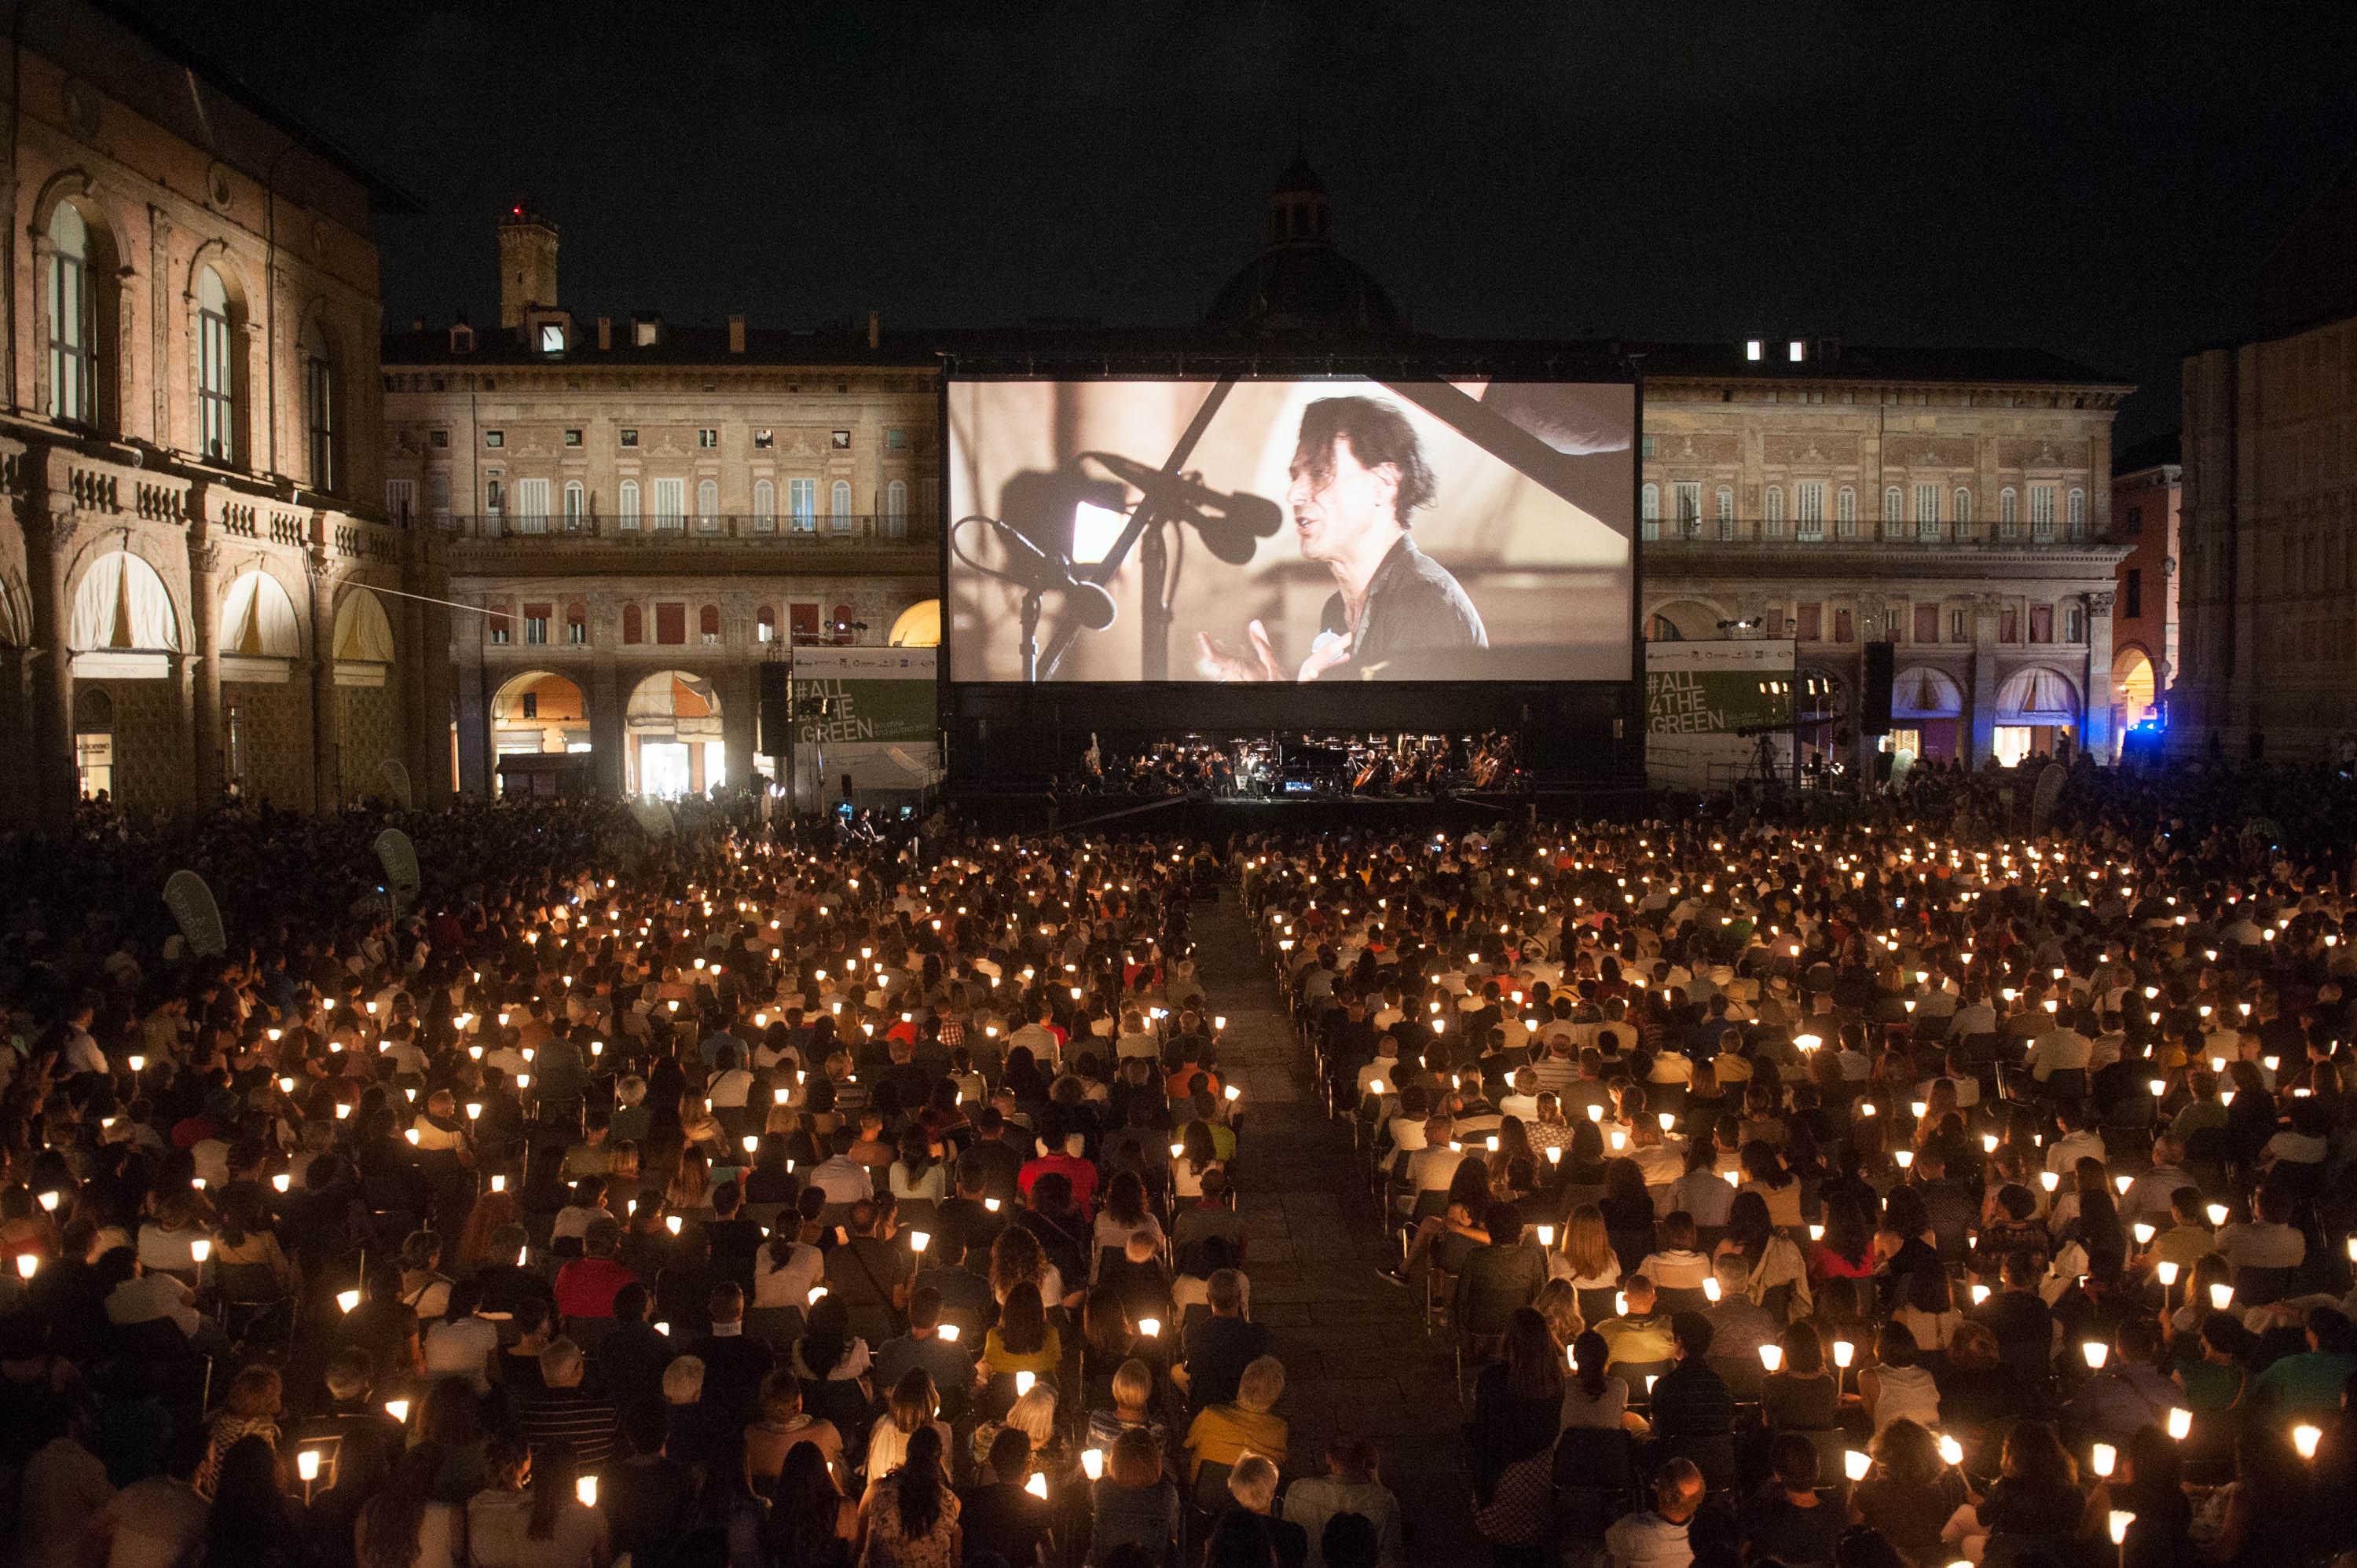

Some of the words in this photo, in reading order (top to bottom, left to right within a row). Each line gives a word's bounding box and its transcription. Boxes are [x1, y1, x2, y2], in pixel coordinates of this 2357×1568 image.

[795, 679, 852, 703] #ALL
[1647, 671, 1703, 694] #ALL
[1649, 690, 1706, 714] 4THE
[801, 717, 874, 742] GREEN
[1651, 709, 1725, 734] GREEN
